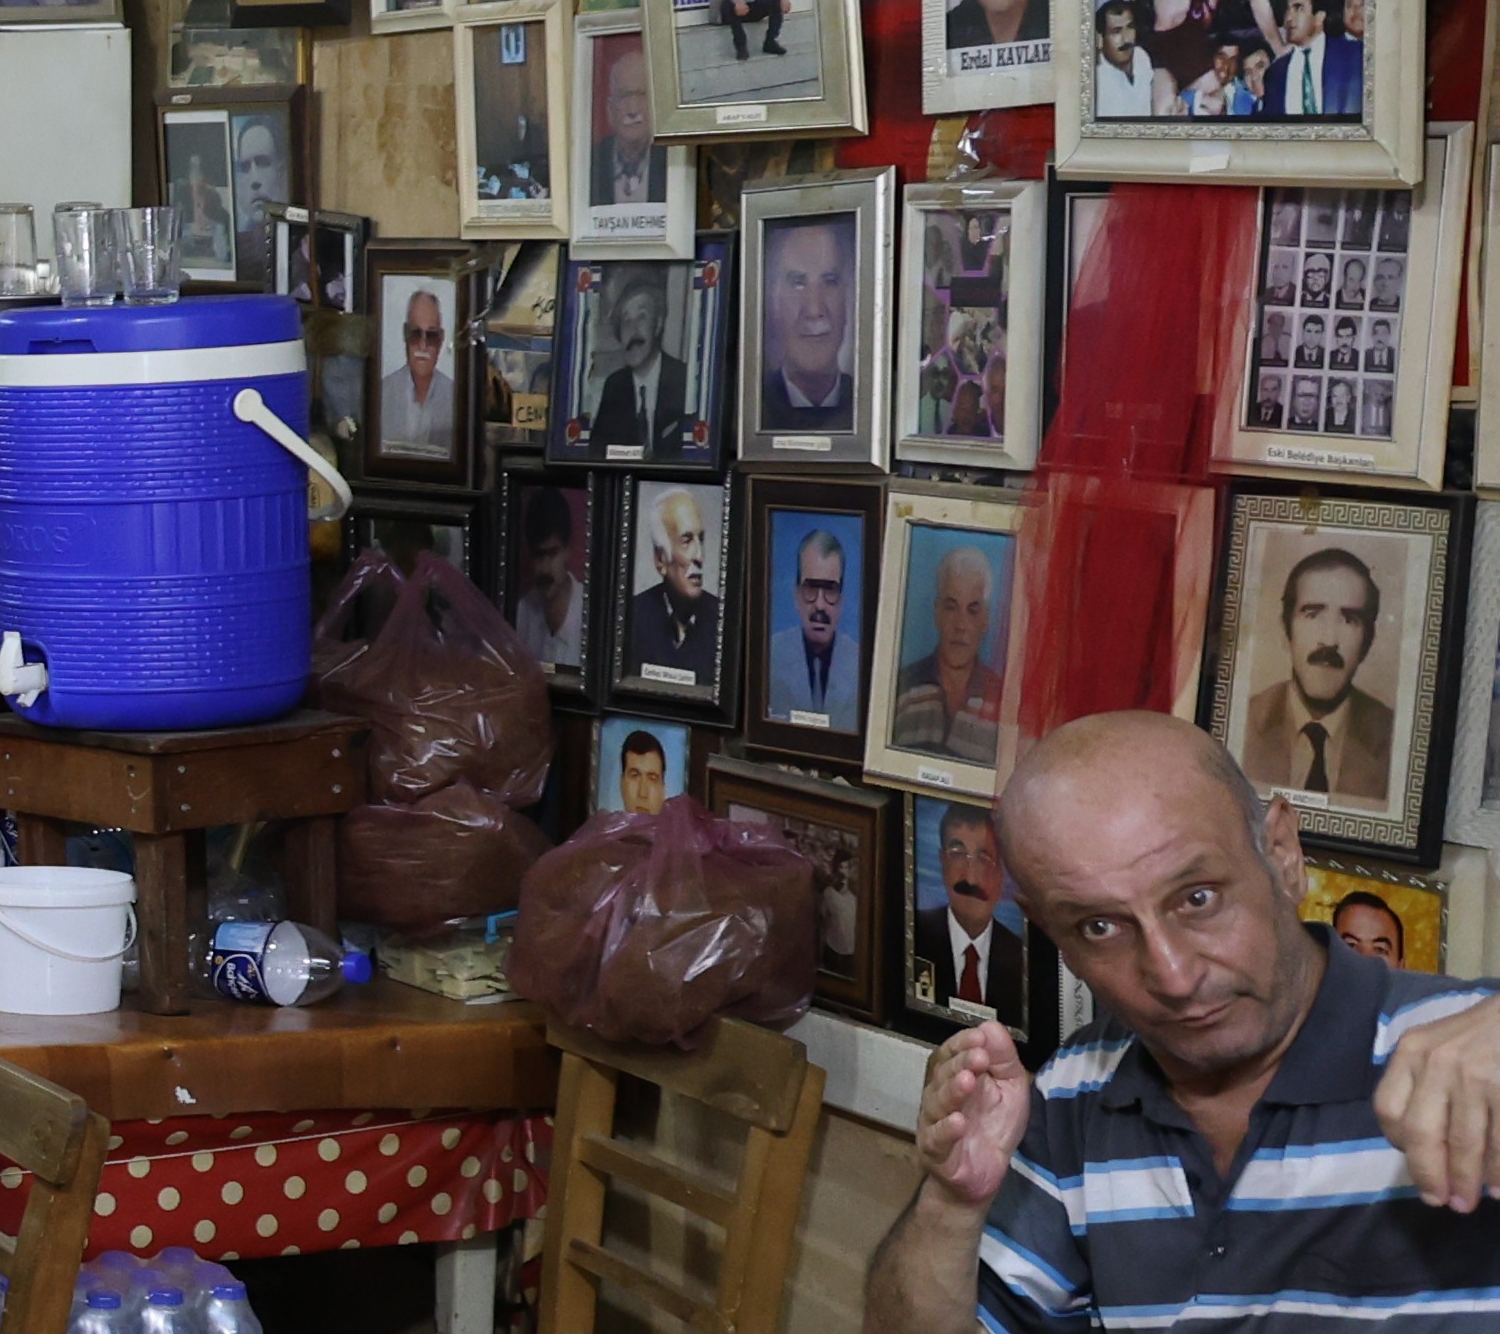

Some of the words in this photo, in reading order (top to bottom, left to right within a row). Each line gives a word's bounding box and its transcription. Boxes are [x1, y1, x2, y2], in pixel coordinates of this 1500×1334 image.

[960, 50, 992, 71] Erdal
[996, 43, 1052, 68] KAVLAK
[631, 215, 669, 229] MEHME
